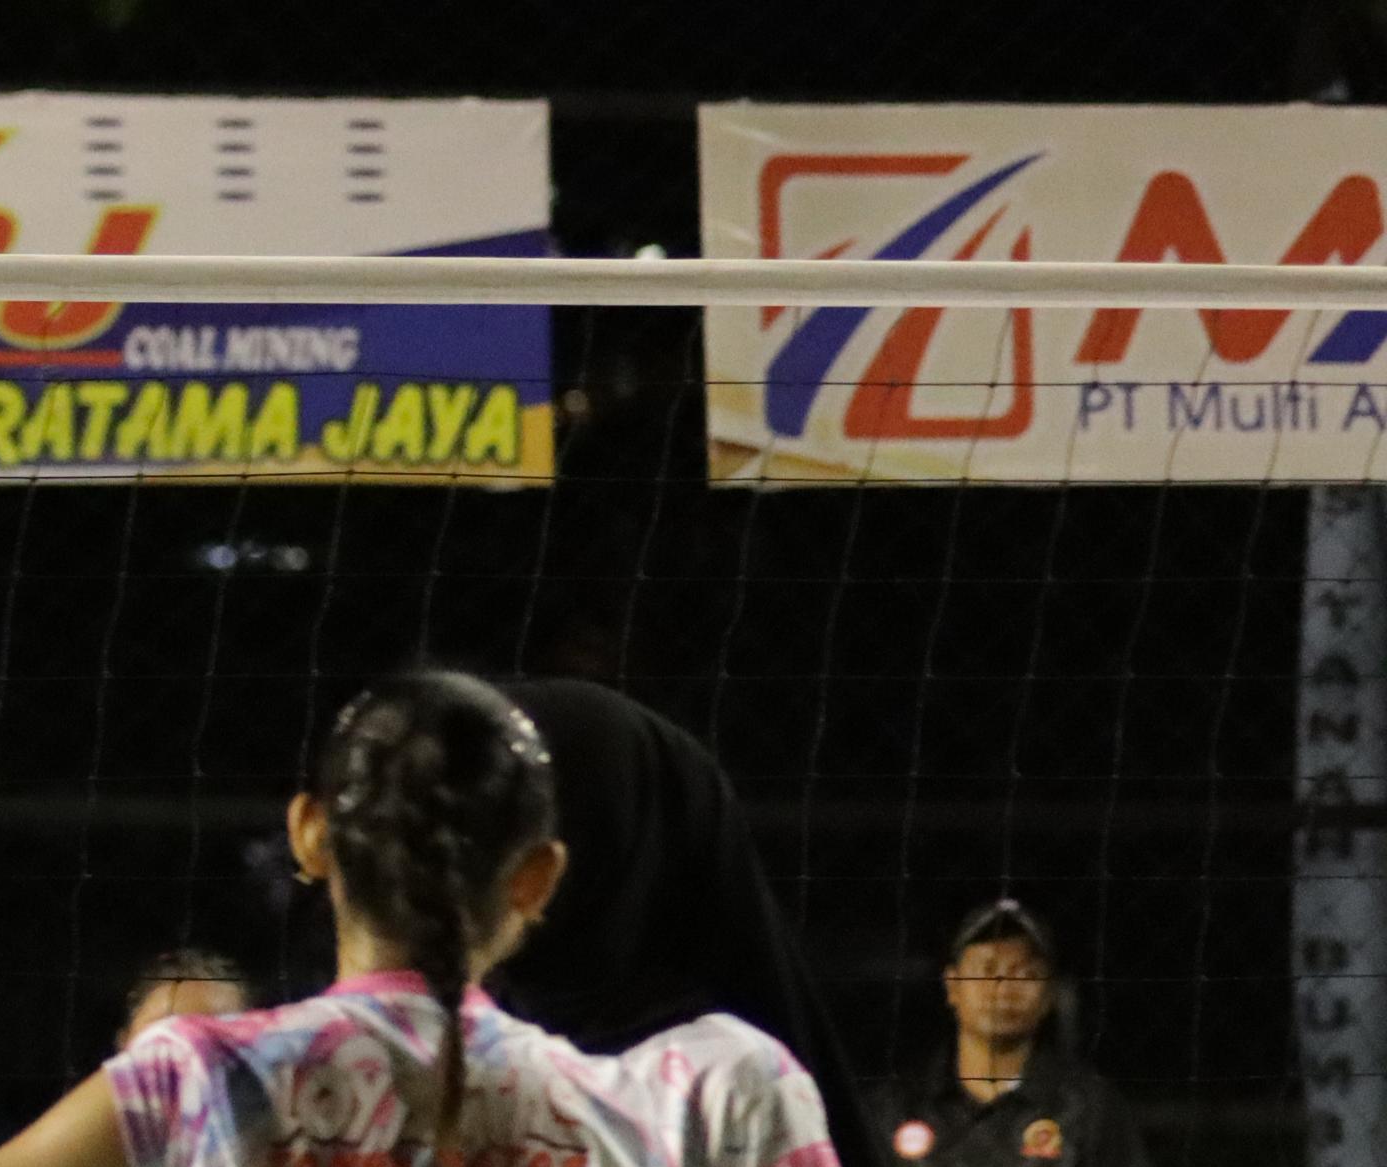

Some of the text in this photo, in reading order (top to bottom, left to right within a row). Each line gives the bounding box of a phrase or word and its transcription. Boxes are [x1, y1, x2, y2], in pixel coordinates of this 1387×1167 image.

[321, 381, 521, 467] JAYA
[1078, 382, 1142, 431] PT
[1167, 382, 1318, 431] Multi
